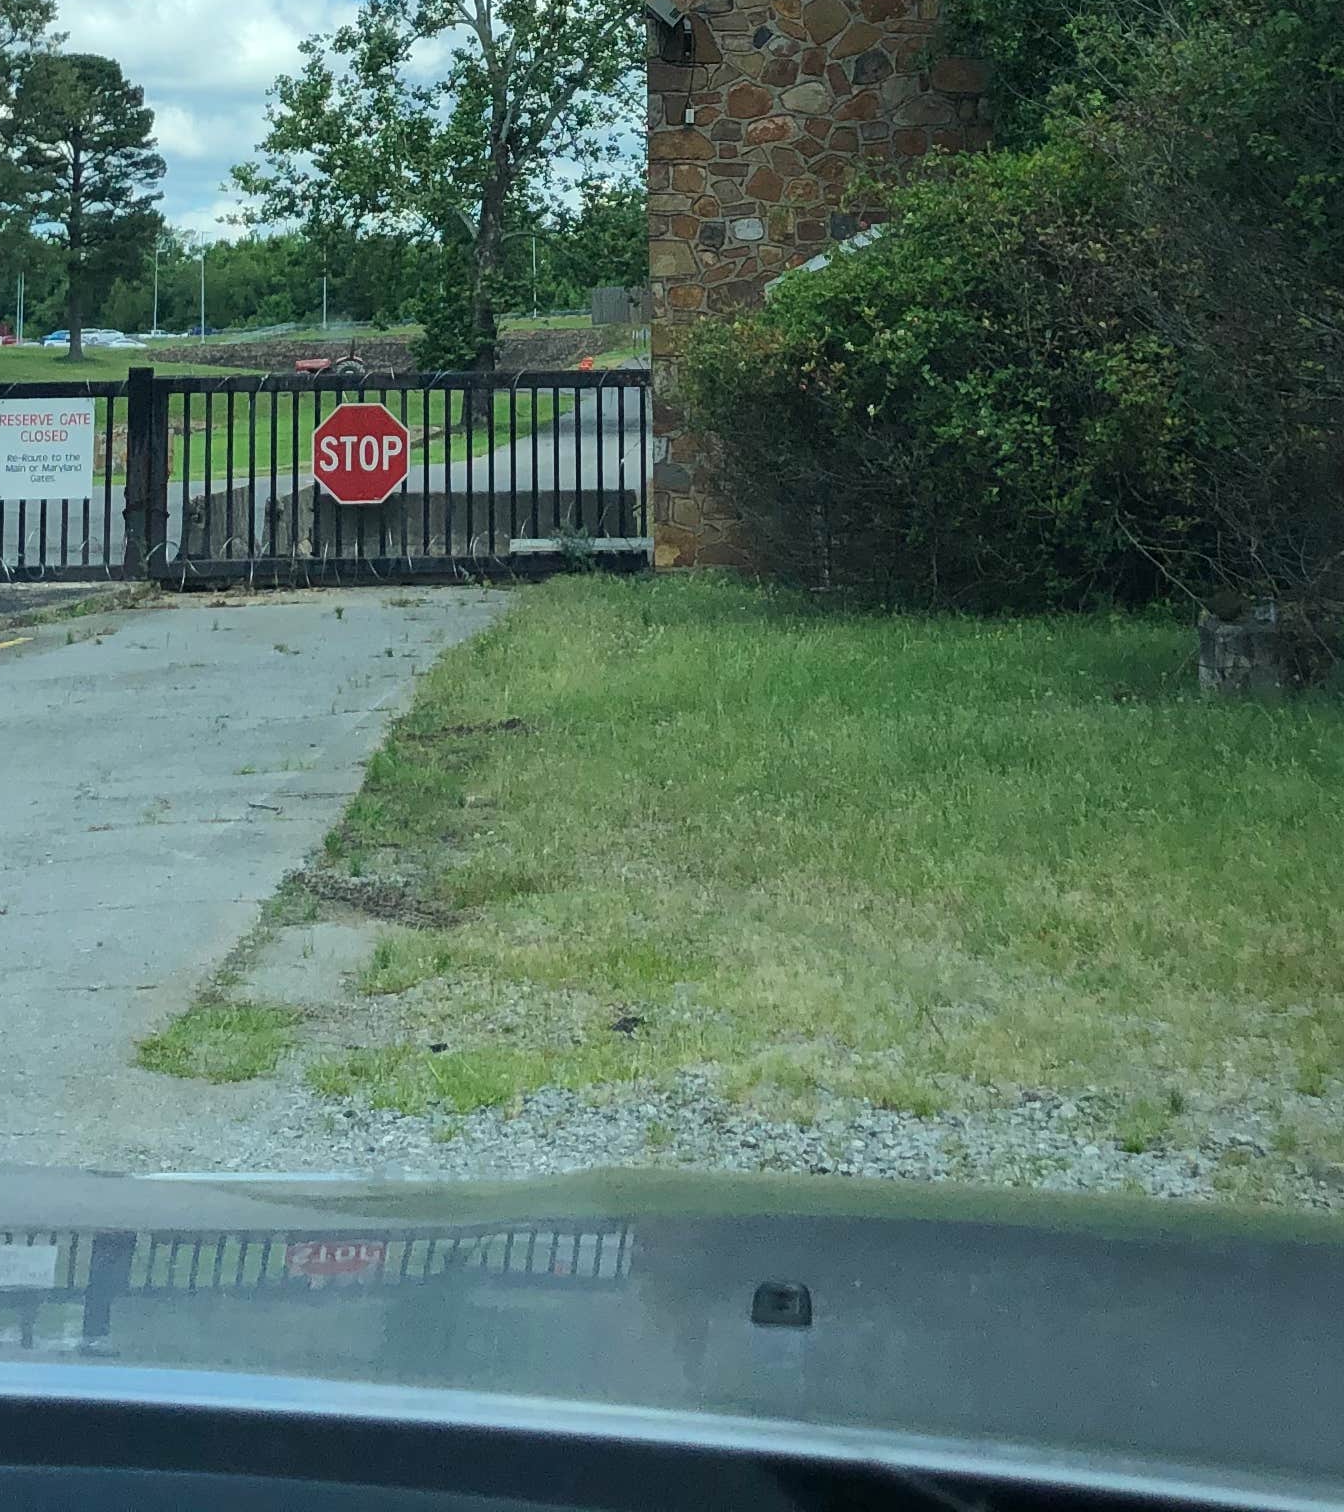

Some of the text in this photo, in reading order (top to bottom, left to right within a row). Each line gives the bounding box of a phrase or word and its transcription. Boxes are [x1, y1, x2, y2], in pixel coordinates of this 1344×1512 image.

[0, 413, 91, 426] RESERVE GATE
[20, 430, 68, 442] CLOSED
[7, 454, 80, 462] Re-Route to the
[319, 435, 403, 472] STOP
[5, 464, 26, 472] Main
[42, 463, 82, 473] Maryland
